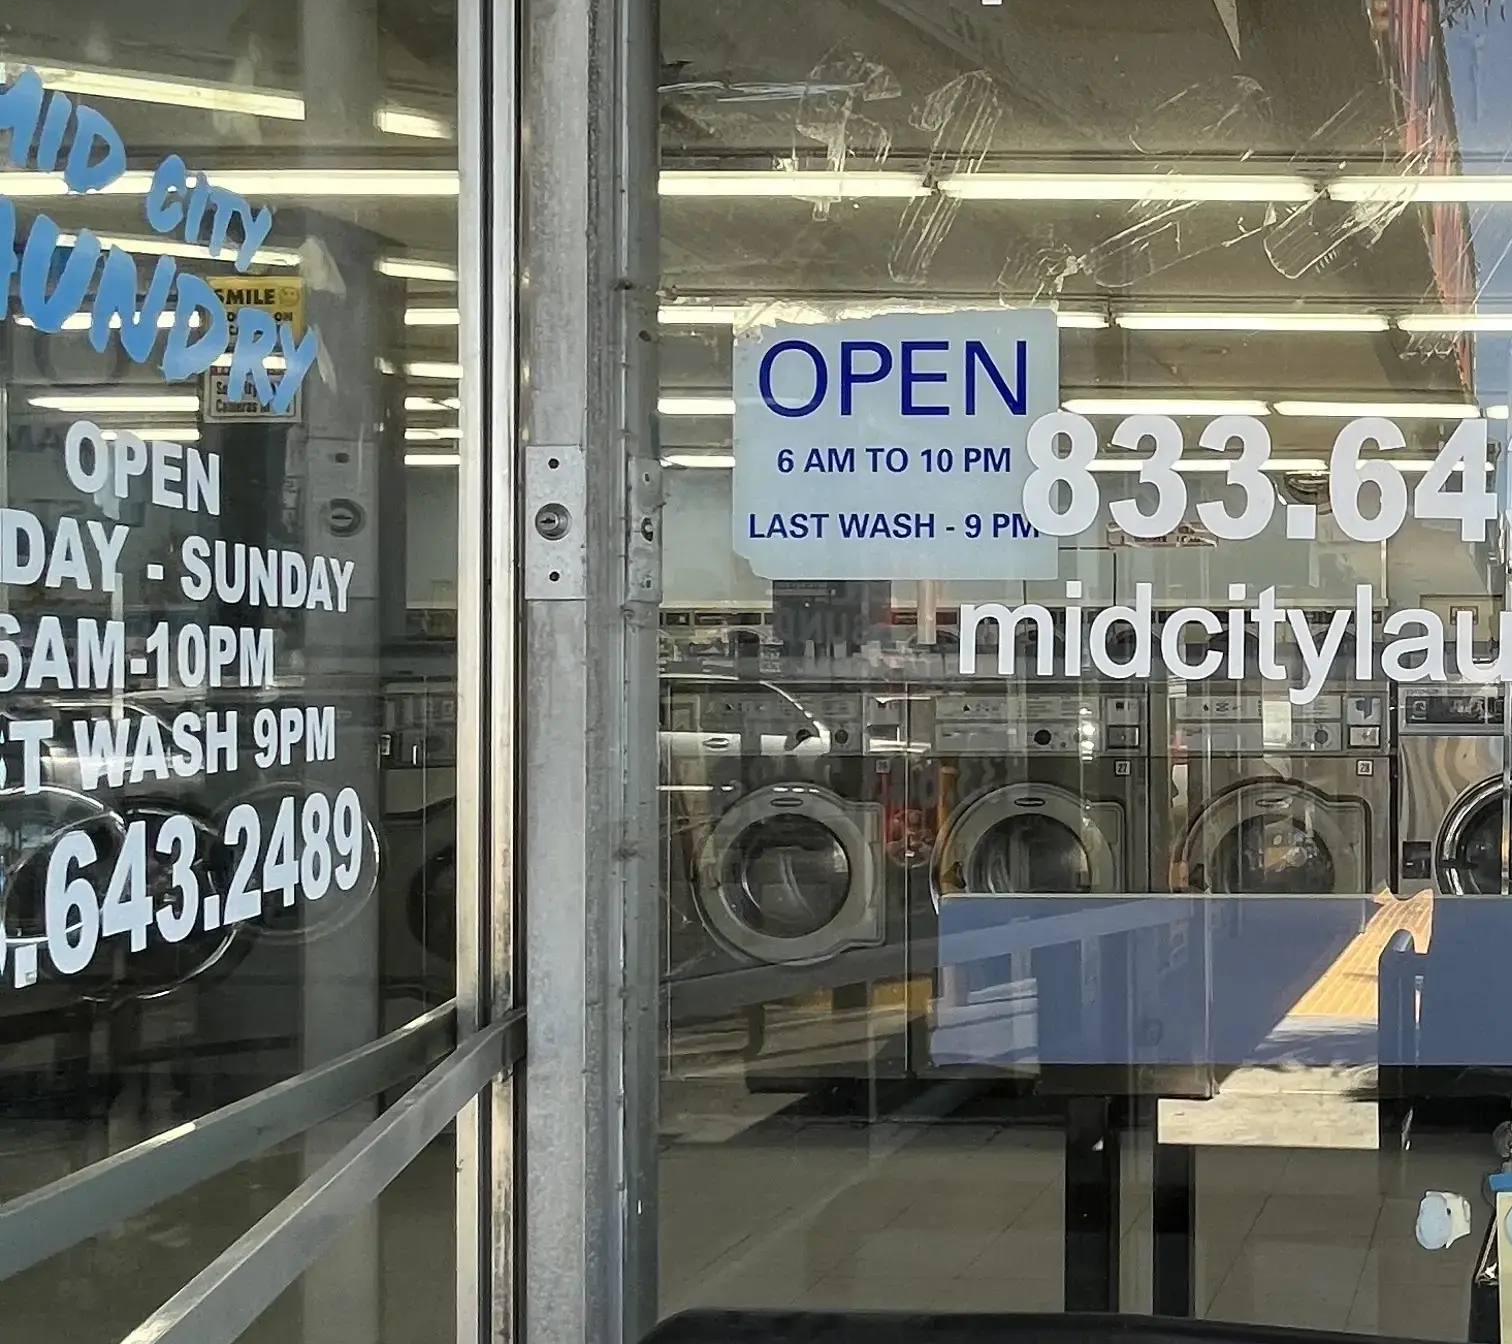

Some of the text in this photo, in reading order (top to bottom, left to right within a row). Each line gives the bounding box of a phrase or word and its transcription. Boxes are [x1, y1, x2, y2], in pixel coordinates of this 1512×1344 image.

[145, 154, 273, 272] CITY
[215, 400, 258, 414] Cameras
[758, 339, 1028, 418] OPEN
[65, 419, 221, 516] OPEN
[777, 447, 1012, 474] 6 AM TO 10 PM
[749, 513, 829, 539] LAST
[839, 513, 935, 539] WASH
[964, 513, 982, 539] 9
[992, 513, 1040, 539] PM
[181, 534, 355, 613] SUNDAY
[72, 710, 238, 792] WASH
[253, 706, 336, 769] 9PM
[0, 786, 363, 990] .643.2489
